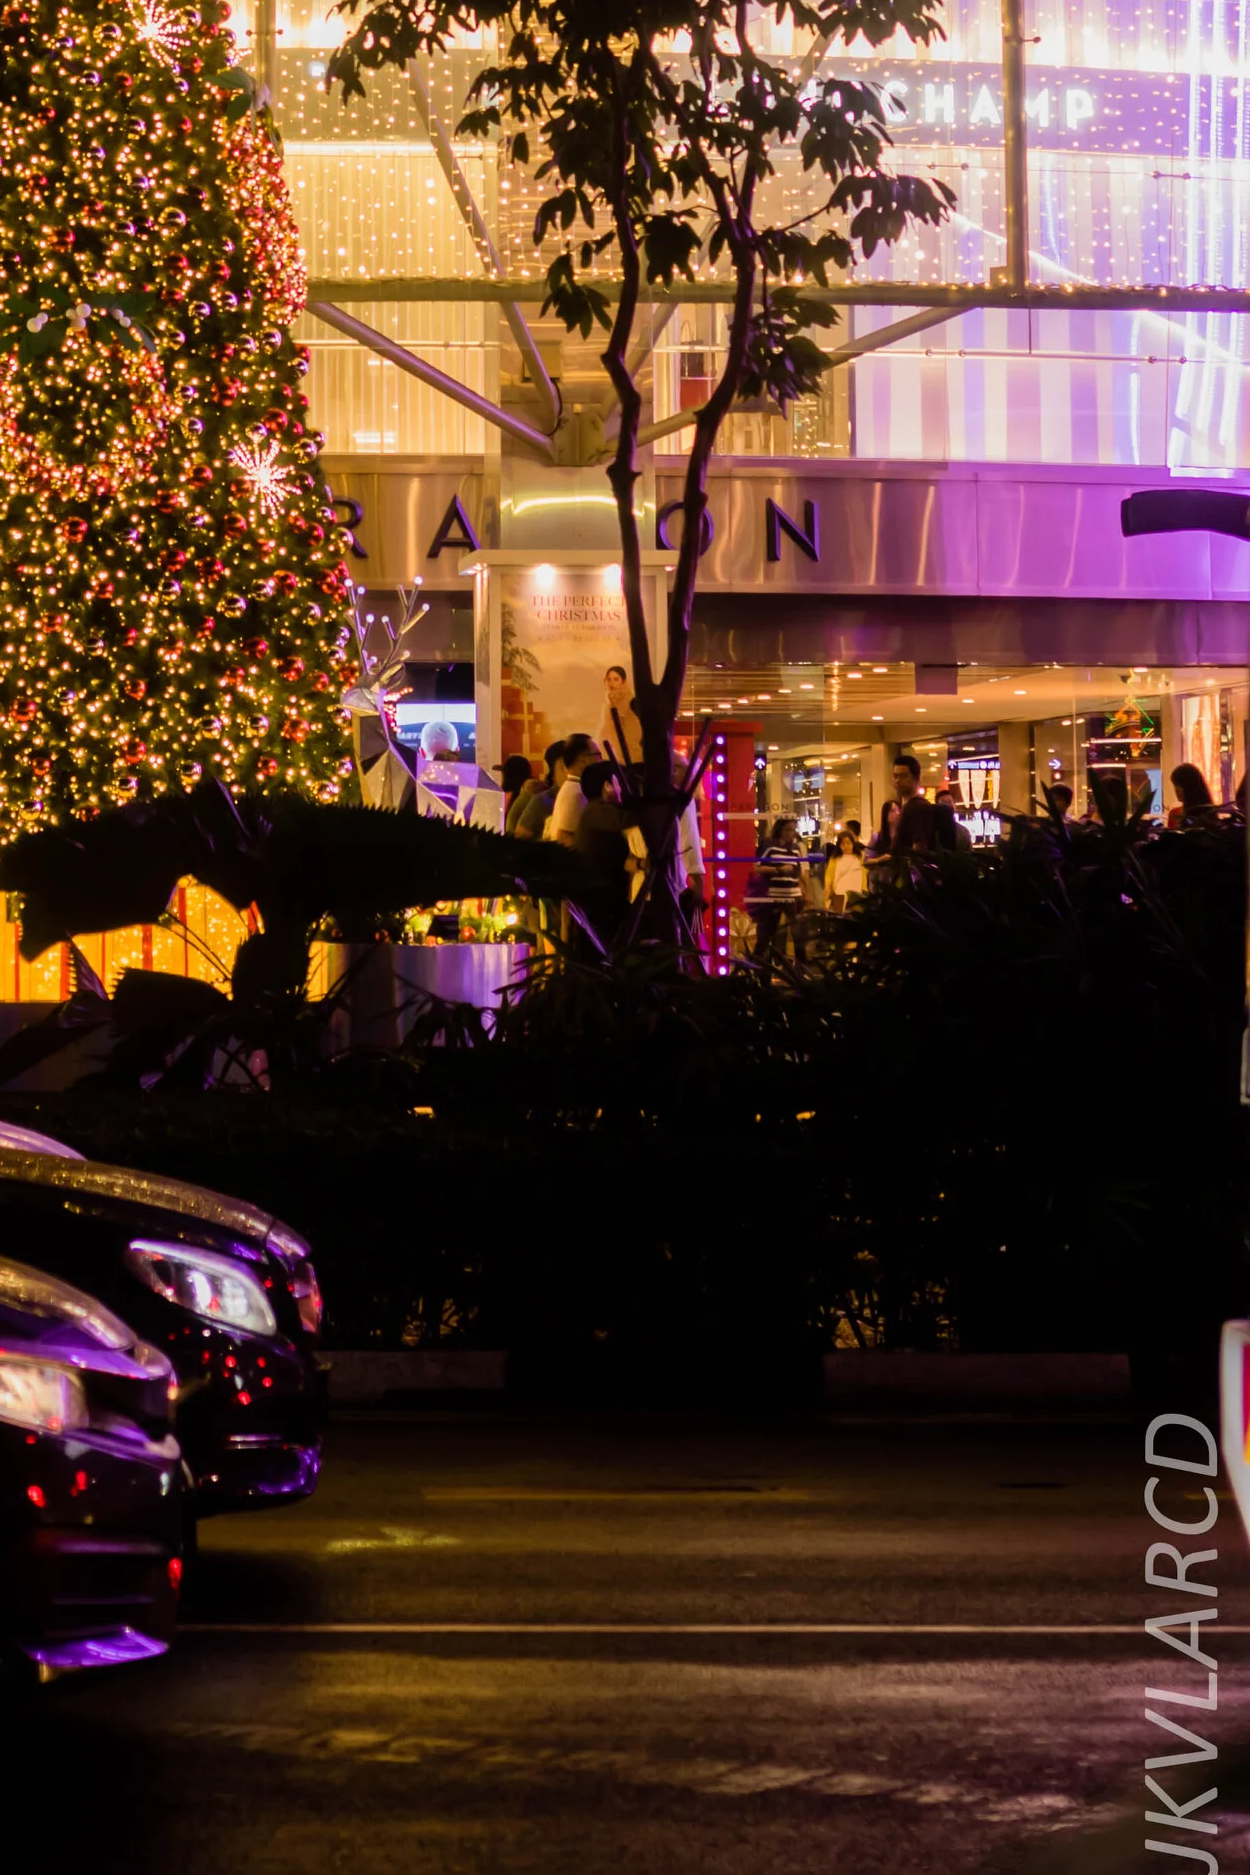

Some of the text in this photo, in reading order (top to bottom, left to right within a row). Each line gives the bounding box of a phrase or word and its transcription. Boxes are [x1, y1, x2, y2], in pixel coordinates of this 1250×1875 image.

[532, 595, 626, 607] THE PERFECT
[536, 609, 621, 621] CHRISTMAS
